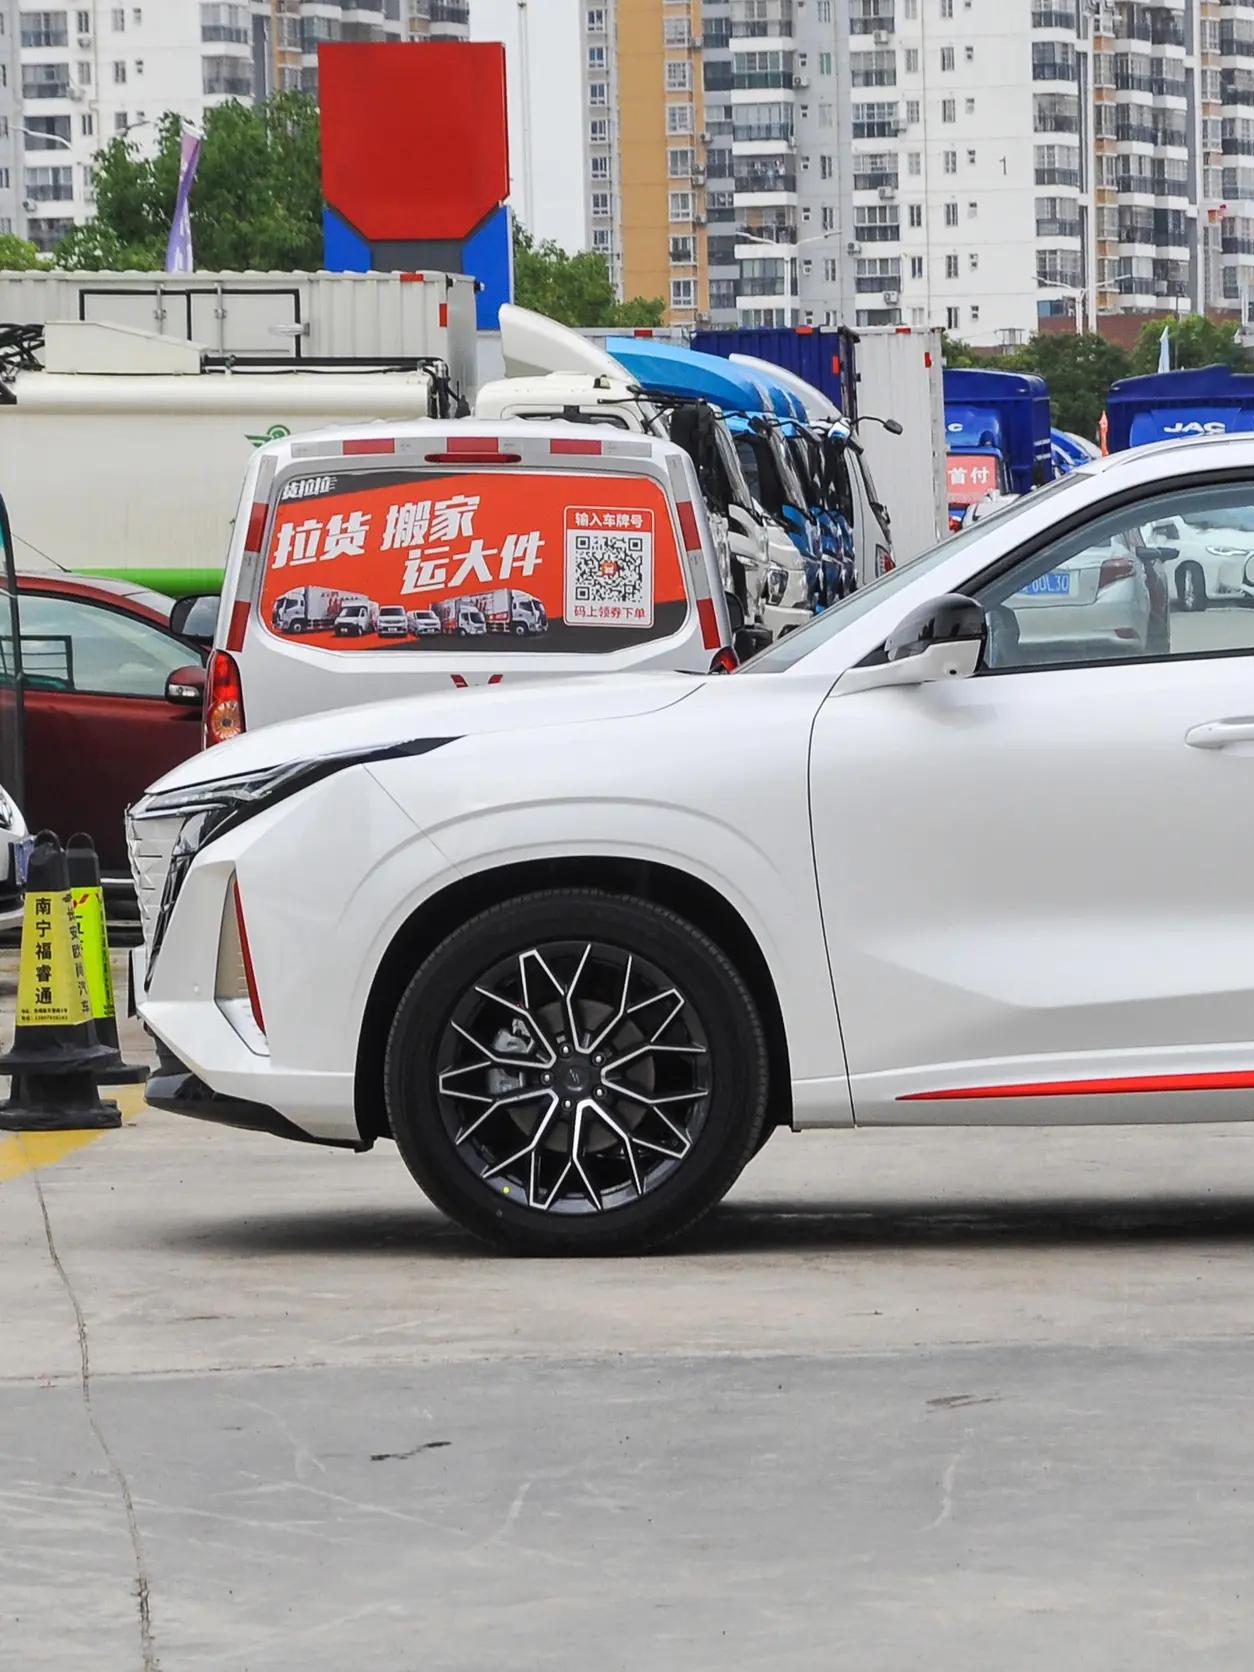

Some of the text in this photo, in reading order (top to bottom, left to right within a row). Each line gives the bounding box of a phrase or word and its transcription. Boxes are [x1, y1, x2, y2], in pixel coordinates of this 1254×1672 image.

[1163, 422, 1226, 434] JAC
[271, 494, 481, 570] 拉货 搬家
[575, 512, 643, 528] 输入车牌号
[400, 530, 545, 595] 运大件
[574, 605, 645, 619] 码上领券下单
[35, 897, 52, 1005] 南宁福睿通
